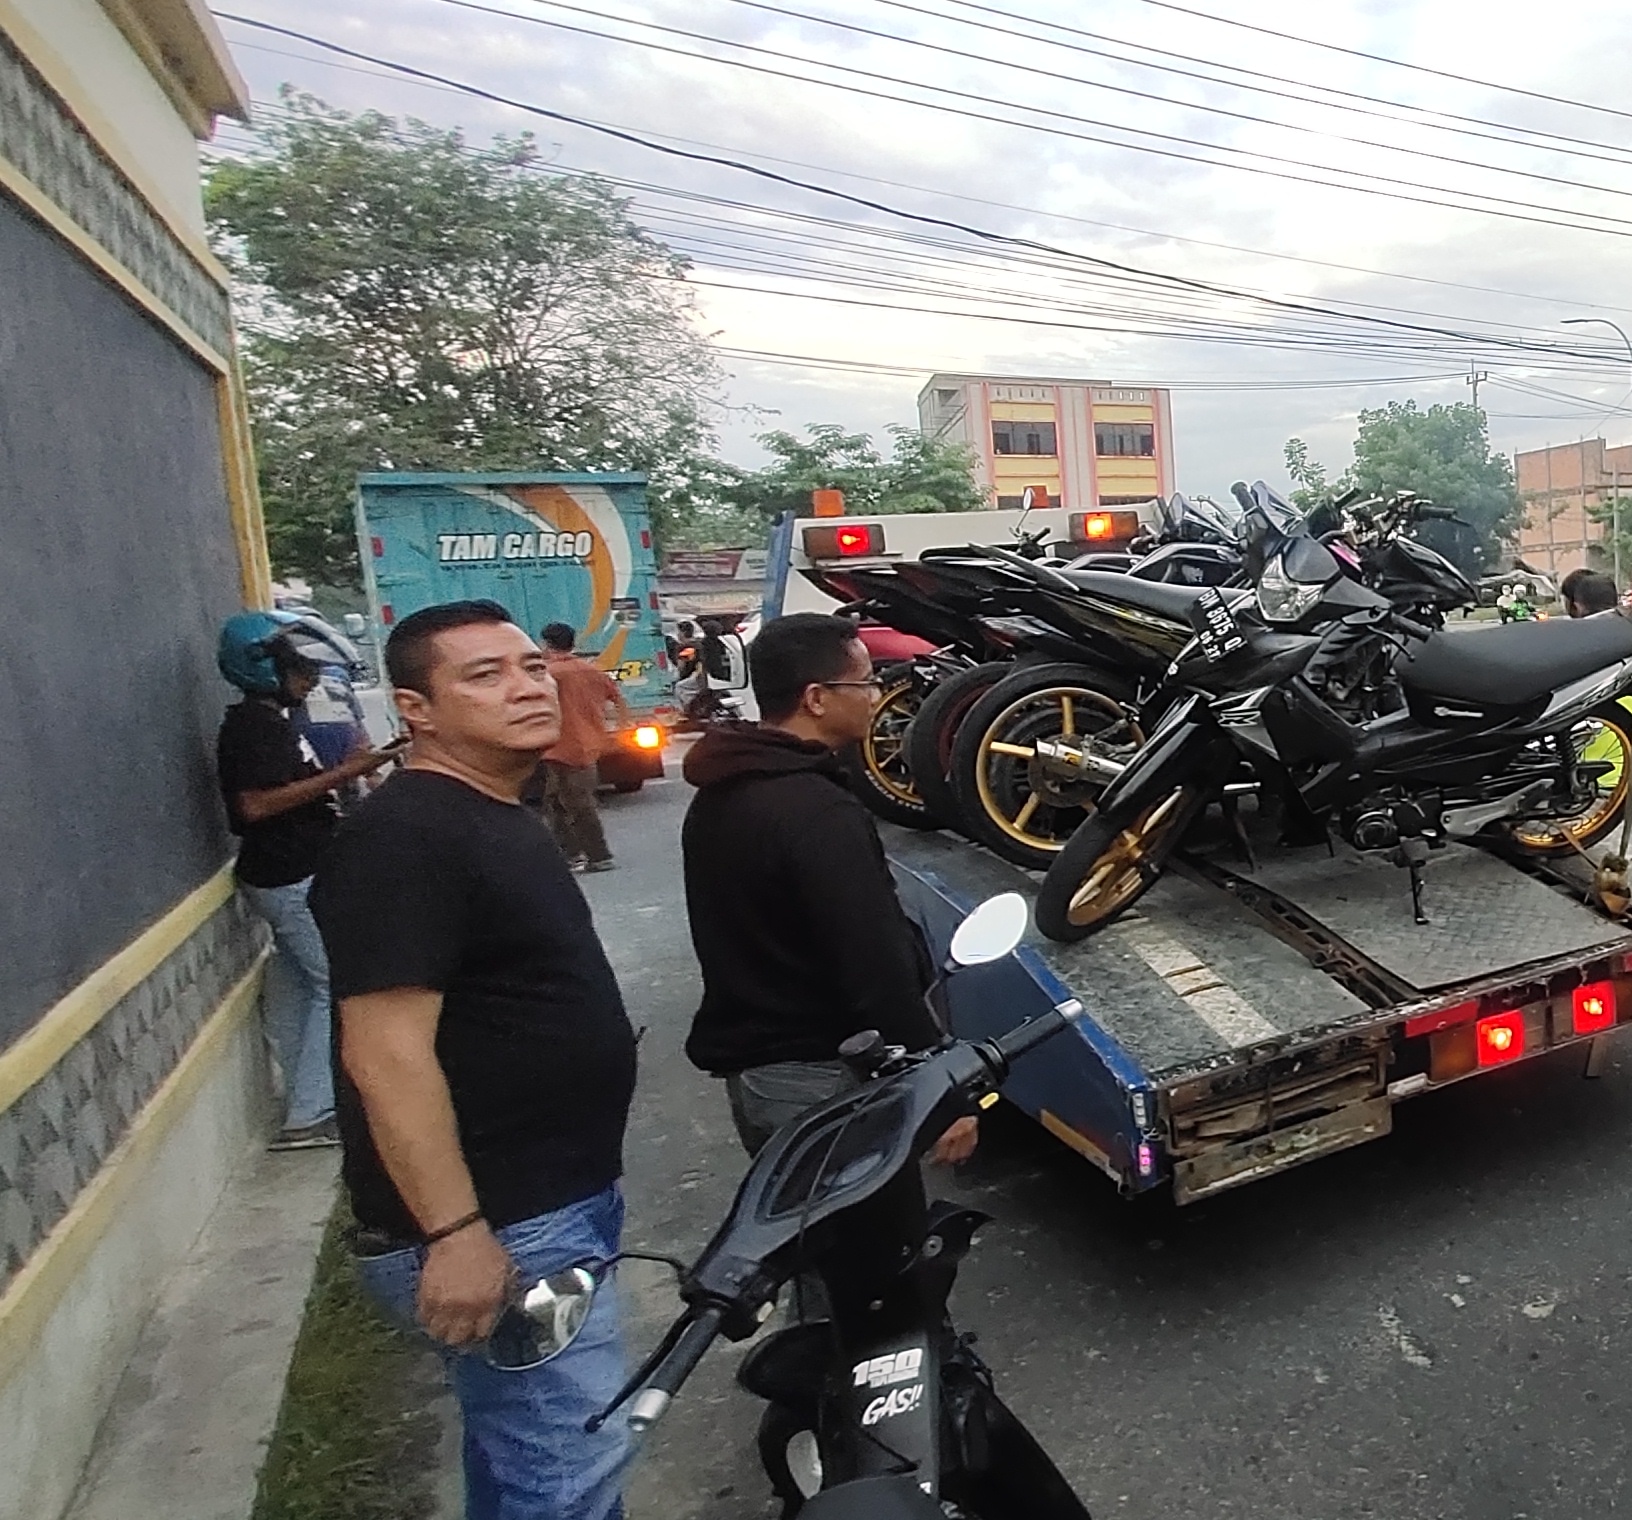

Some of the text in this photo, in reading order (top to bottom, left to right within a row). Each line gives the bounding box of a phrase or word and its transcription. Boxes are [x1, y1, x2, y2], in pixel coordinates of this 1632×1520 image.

[437, 531, 593, 561] TAM CARGO
[852, 1348, 923, 1386] 150
[862, 1384, 924, 1426] GAS!!
